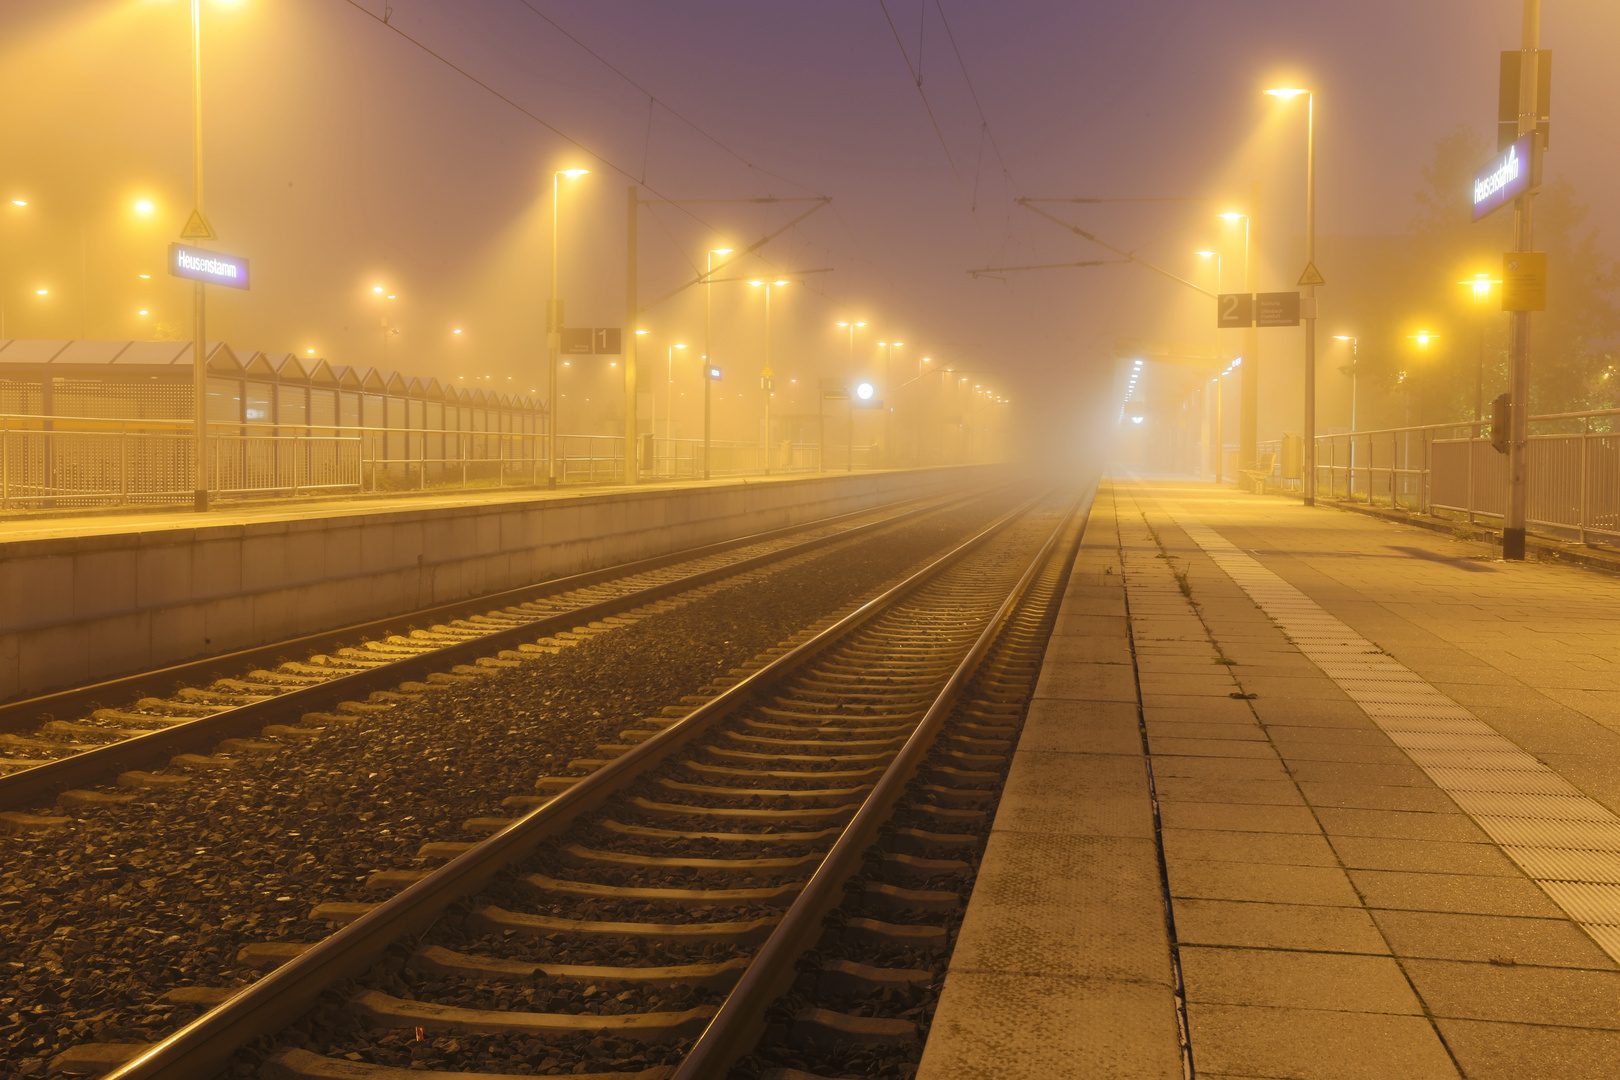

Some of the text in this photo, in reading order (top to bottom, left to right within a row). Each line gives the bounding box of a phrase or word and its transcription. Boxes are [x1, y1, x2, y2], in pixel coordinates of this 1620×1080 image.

[178, 249, 237, 278] Heusenstamm
[1222, 295, 1239, 320] 2
[598, 329, 607, 349] 1
